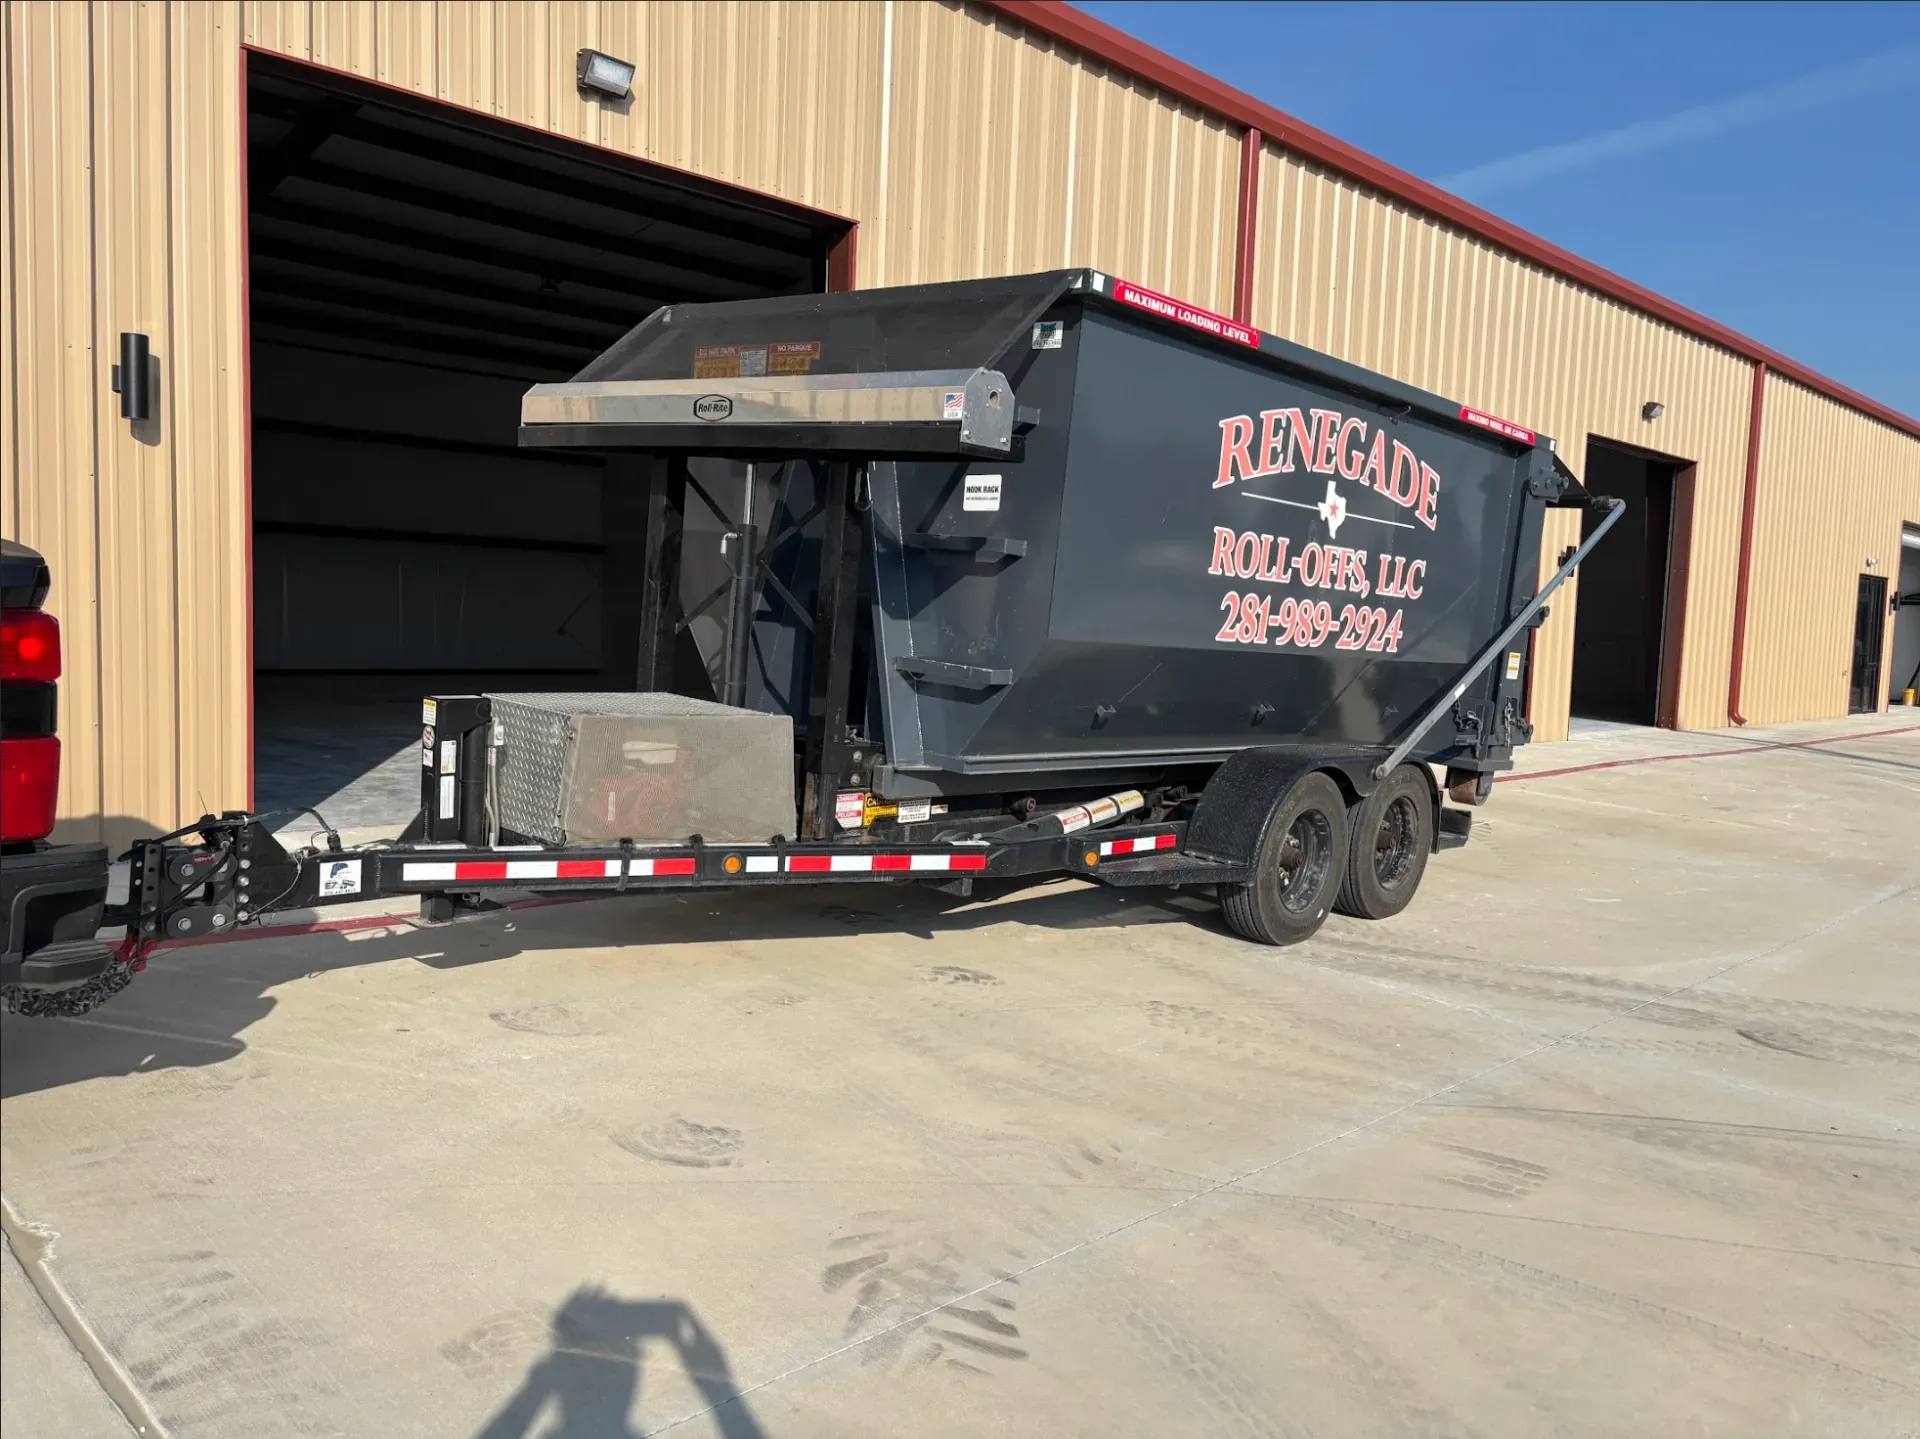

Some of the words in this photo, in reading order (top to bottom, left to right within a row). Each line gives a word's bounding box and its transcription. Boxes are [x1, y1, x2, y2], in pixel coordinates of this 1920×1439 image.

[1124, 289, 1175, 317] MAXIMUM
[1177, 308, 1221, 333] LOADING
[1222, 325, 1251, 344] LEVEL
[720, 346, 736, 354] PARK
[1212, 407, 1441, 531] RENEGADE
[1208, 526, 1371, 599] ROLL-OFFS,
[1375, 553, 1427, 600] LLC
[1215, 591, 1404, 653] 281-989-2924
